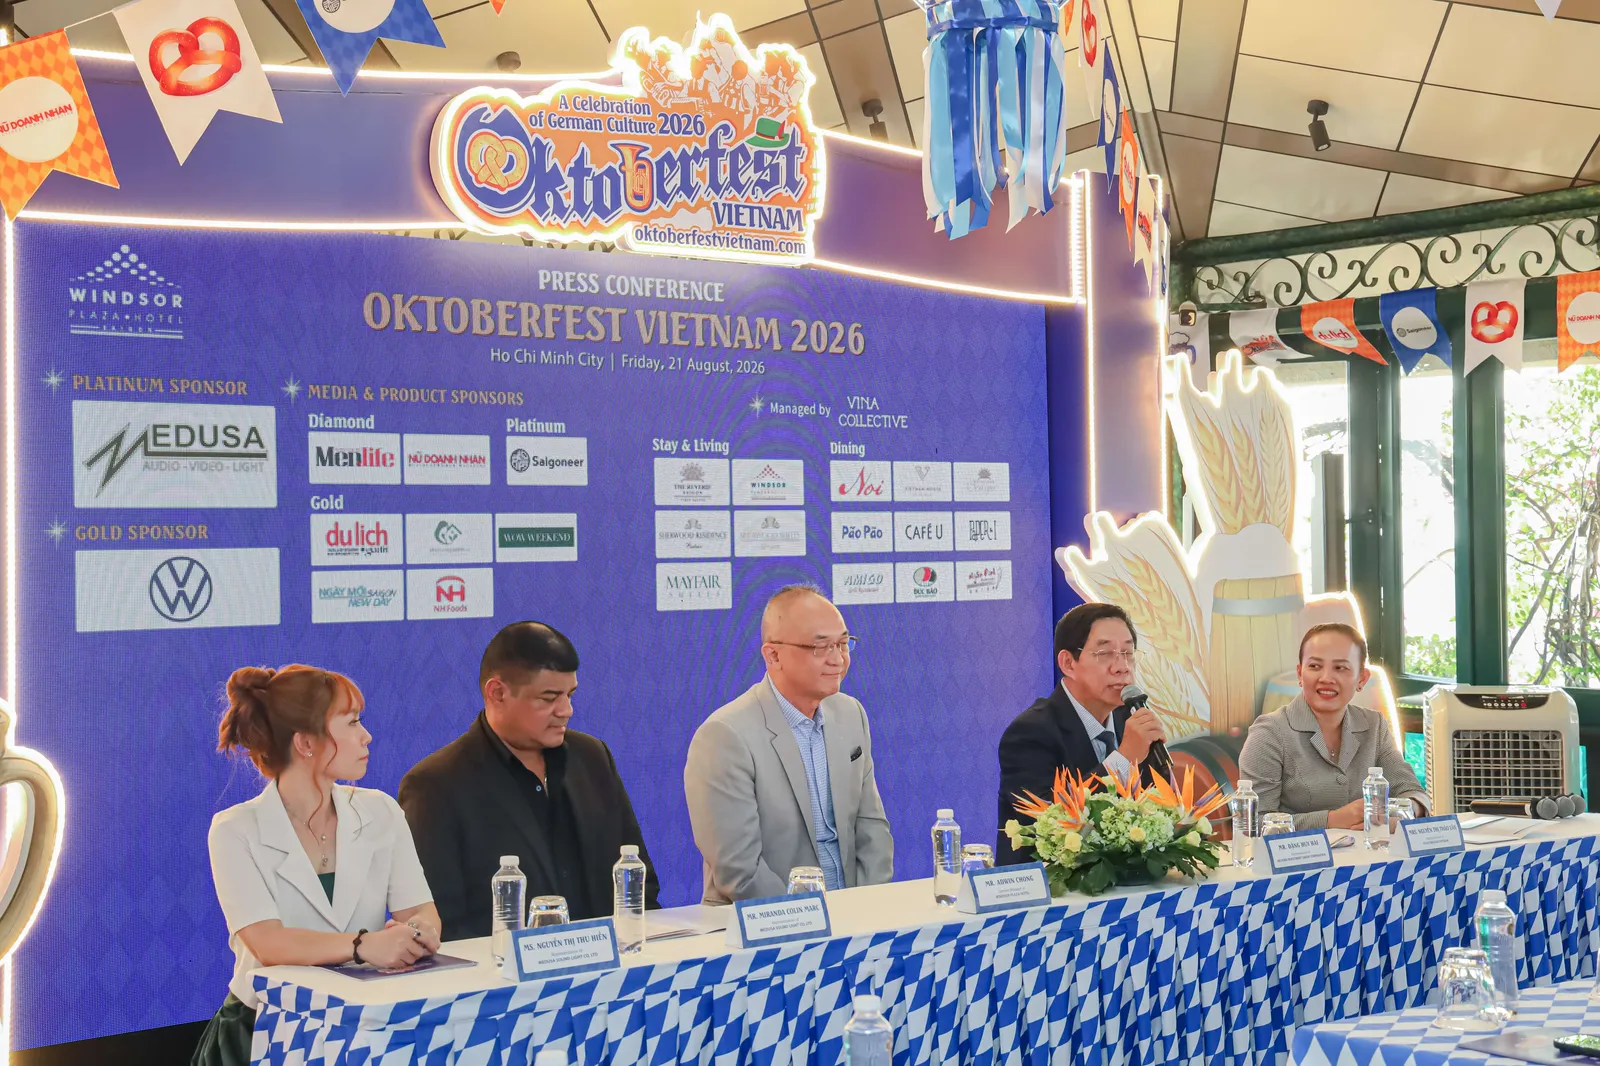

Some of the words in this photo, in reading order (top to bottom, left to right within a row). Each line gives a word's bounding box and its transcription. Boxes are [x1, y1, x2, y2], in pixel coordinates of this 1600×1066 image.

[558, 94, 569, 111] A
[573, 97, 651, 115] Celebration
[10, 113, 44, 130] DOANH
[529, 111, 544, 128] of
[547, 114, 603, 132] German
[607, 116, 656, 134] Culture
[657, 113, 705, 136] 2026
[456, 106, 807, 224] Oktoberfest
[713, 202, 804, 232] VIETNAM
[635, 225, 806, 254] oktoberfestvietnam.com
[538, 269, 599, 294] PRESS
[605, 274, 725, 302] CONFERENCE
[69, 287, 183, 308] WINDSOR
[363, 291, 627, 342] OKTOBERFEST
[635, 308, 783, 351] VIETNAM
[791, 318, 866, 356] 2026
[490, 348, 511, 363] Ho
[514, 349, 537, 364] Chi
[541, 350, 575, 365] Minh
[578, 352, 605, 371] City
[622, 354, 665, 372] Friday,
[669, 357, 683, 370] 21
[687, 357, 734, 375] August,
[737, 360, 766, 375] 2026
[72, 374, 164, 393] PLATINUM
[170, 378, 248, 396] SPONSOR
[308, 384, 357, 400] MEDIA
[363, 386, 374, 400] &
[380, 387, 447, 403] PRODUCT
[451, 389, 524, 406] SPONSORS
[847, 395, 880, 410] VINA
[770, 402, 816, 417] Managed
[819, 403, 831, 418] by
[308, 413, 375, 430] Diamond
[506, 418, 566, 434] Platinum
[839, 413, 908, 429] COLLECTIVE
[652, 438, 677, 454] Stay
[682, 440, 691, 453] &
[694, 439, 730, 456] Living
[830, 441, 865, 457] Dining
[316, 446, 395, 468] Menlife
[424, 454, 457, 464] DOANH
[532, 456, 584, 469] Saigoneer
[143, 461, 180, 472] AUDIO
[190, 461, 223, 472] VIDEO
[233, 462, 265, 474] LIGHT
[311, 495, 344, 510] Gold
[76, 525, 122, 540] GOLD
[128, 524, 209, 541] SPONSOR
[528, 531, 571, 543] WEEKEND
[905, 523, 932, 540] CAFÉ
[936, 524, 943, 540] U
[666, 574, 721, 590] MAYFAIR
[436, 584, 466, 603] NH
[434, 605, 446, 613] NH
[447, 604, 468, 613] Foods
[997, 877, 1015, 886] ADWIN
[1016, 875, 1034, 883] CHONG
[759, 910, 786, 919] MIRANDA
[786, 907, 803, 915] COLIN
[804, 904, 820, 912] MARC
[577, 936, 590, 944] THU
